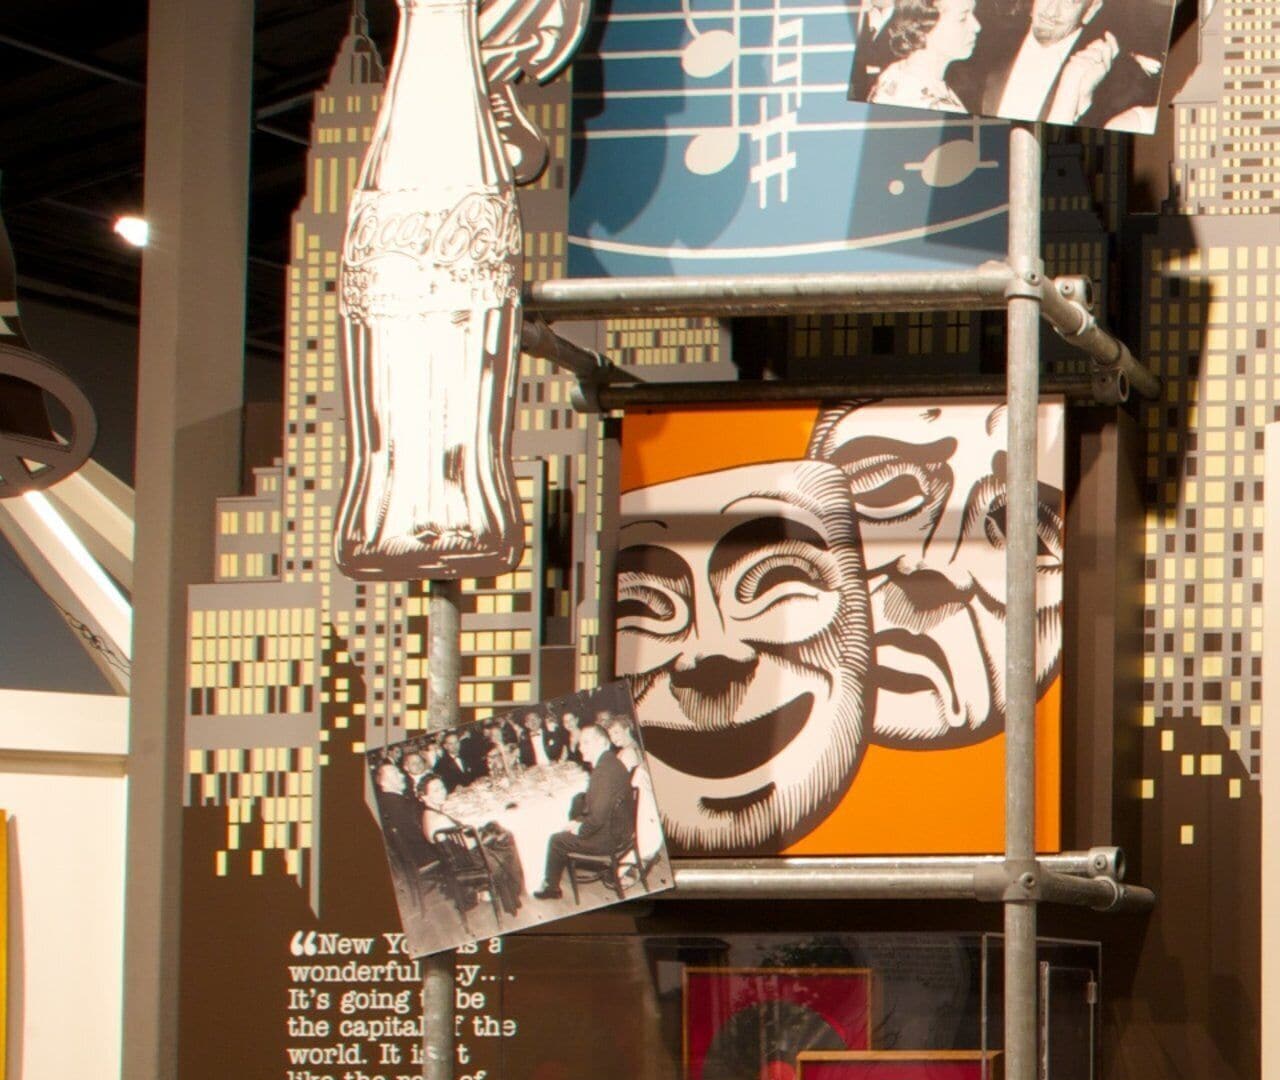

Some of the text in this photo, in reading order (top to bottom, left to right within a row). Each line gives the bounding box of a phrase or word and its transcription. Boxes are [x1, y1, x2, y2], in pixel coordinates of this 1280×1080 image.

[488, 938, 502, 954] a
[288, 961, 420, 983] wonderful
[288, 988, 485, 1014] It’s going be
[288, 1015, 516, 1042] the capital the
[287, 1043, 401, 1064] world. It
